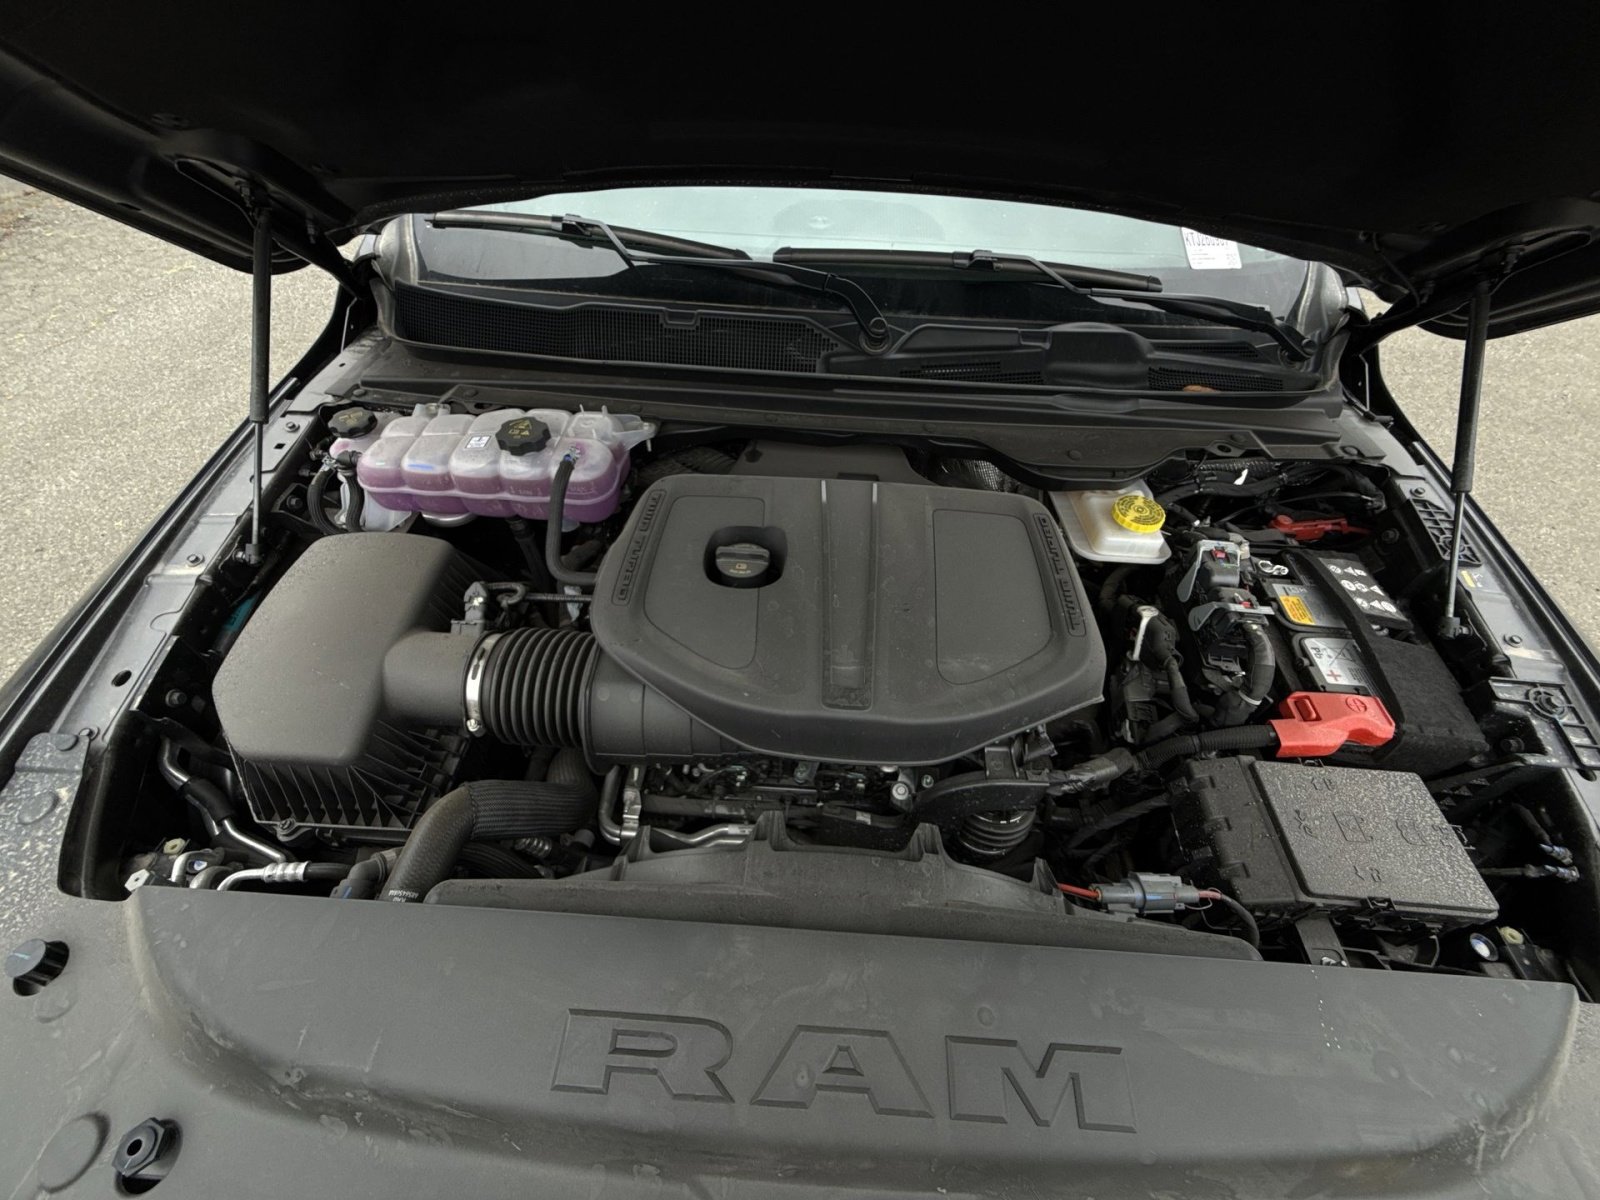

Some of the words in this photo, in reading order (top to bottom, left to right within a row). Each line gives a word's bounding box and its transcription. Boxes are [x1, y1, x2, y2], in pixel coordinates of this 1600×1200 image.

[618, 535, 646, 601] TURBO
[1310, 646, 1324, 660] Pb
[550, 1008, 1138, 1134] RAM
